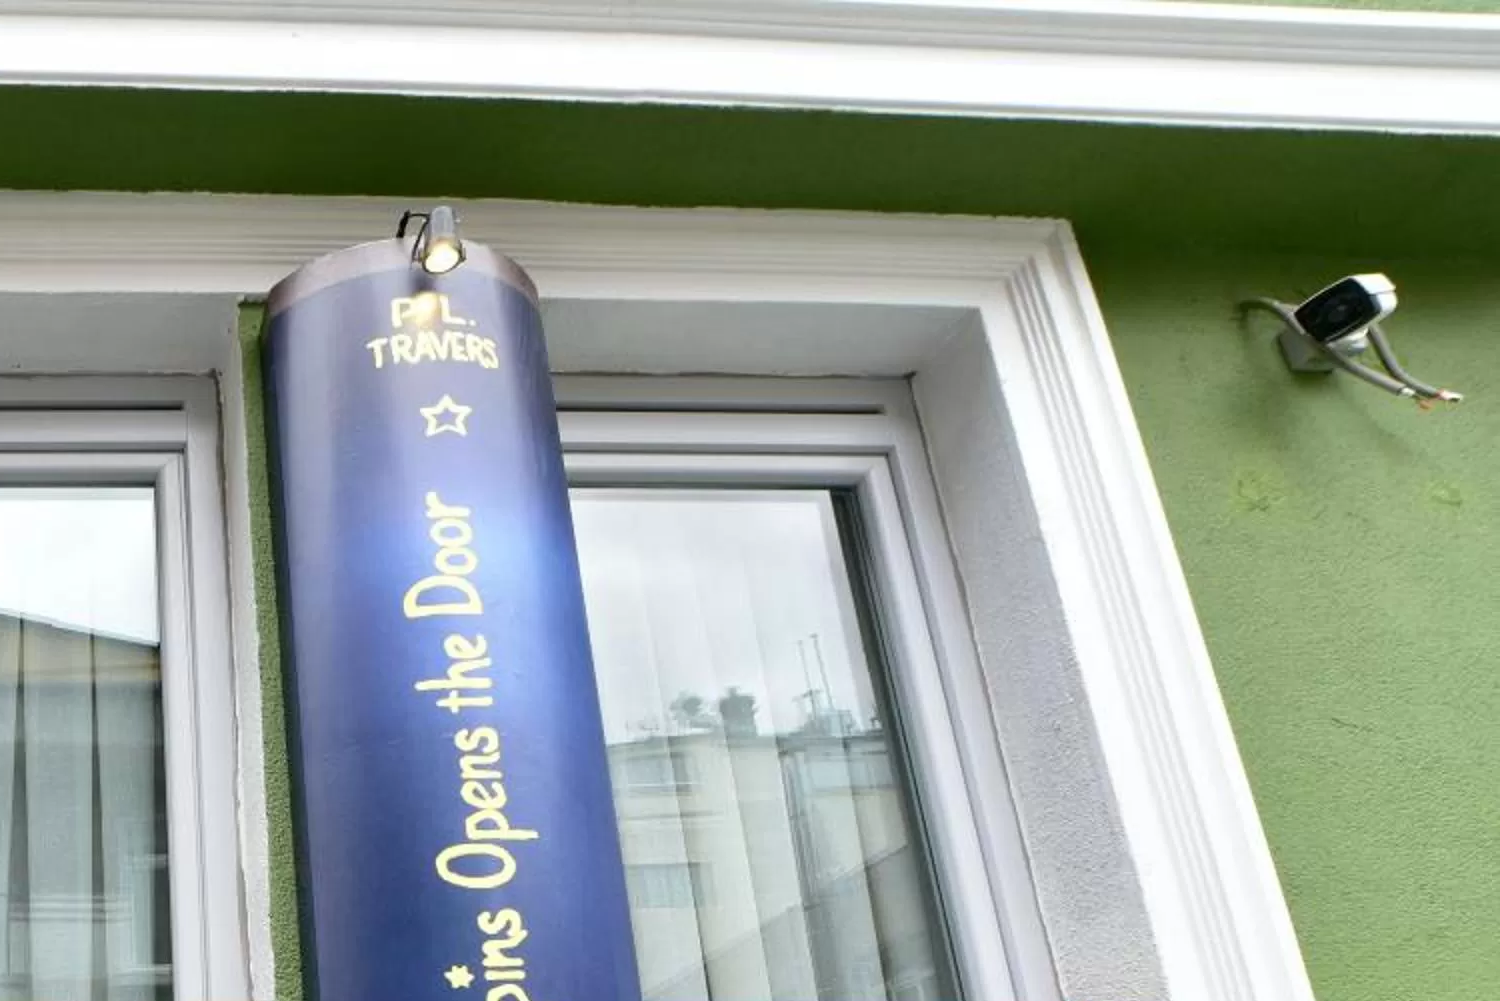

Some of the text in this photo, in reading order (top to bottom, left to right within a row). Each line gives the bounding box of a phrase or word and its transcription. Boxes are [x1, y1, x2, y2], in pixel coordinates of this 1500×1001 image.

[365, 329, 499, 369] TRAVERS
[403, 491, 484, 619] Door
[414, 632, 494, 714] the
[435, 724, 539, 890] Opens
